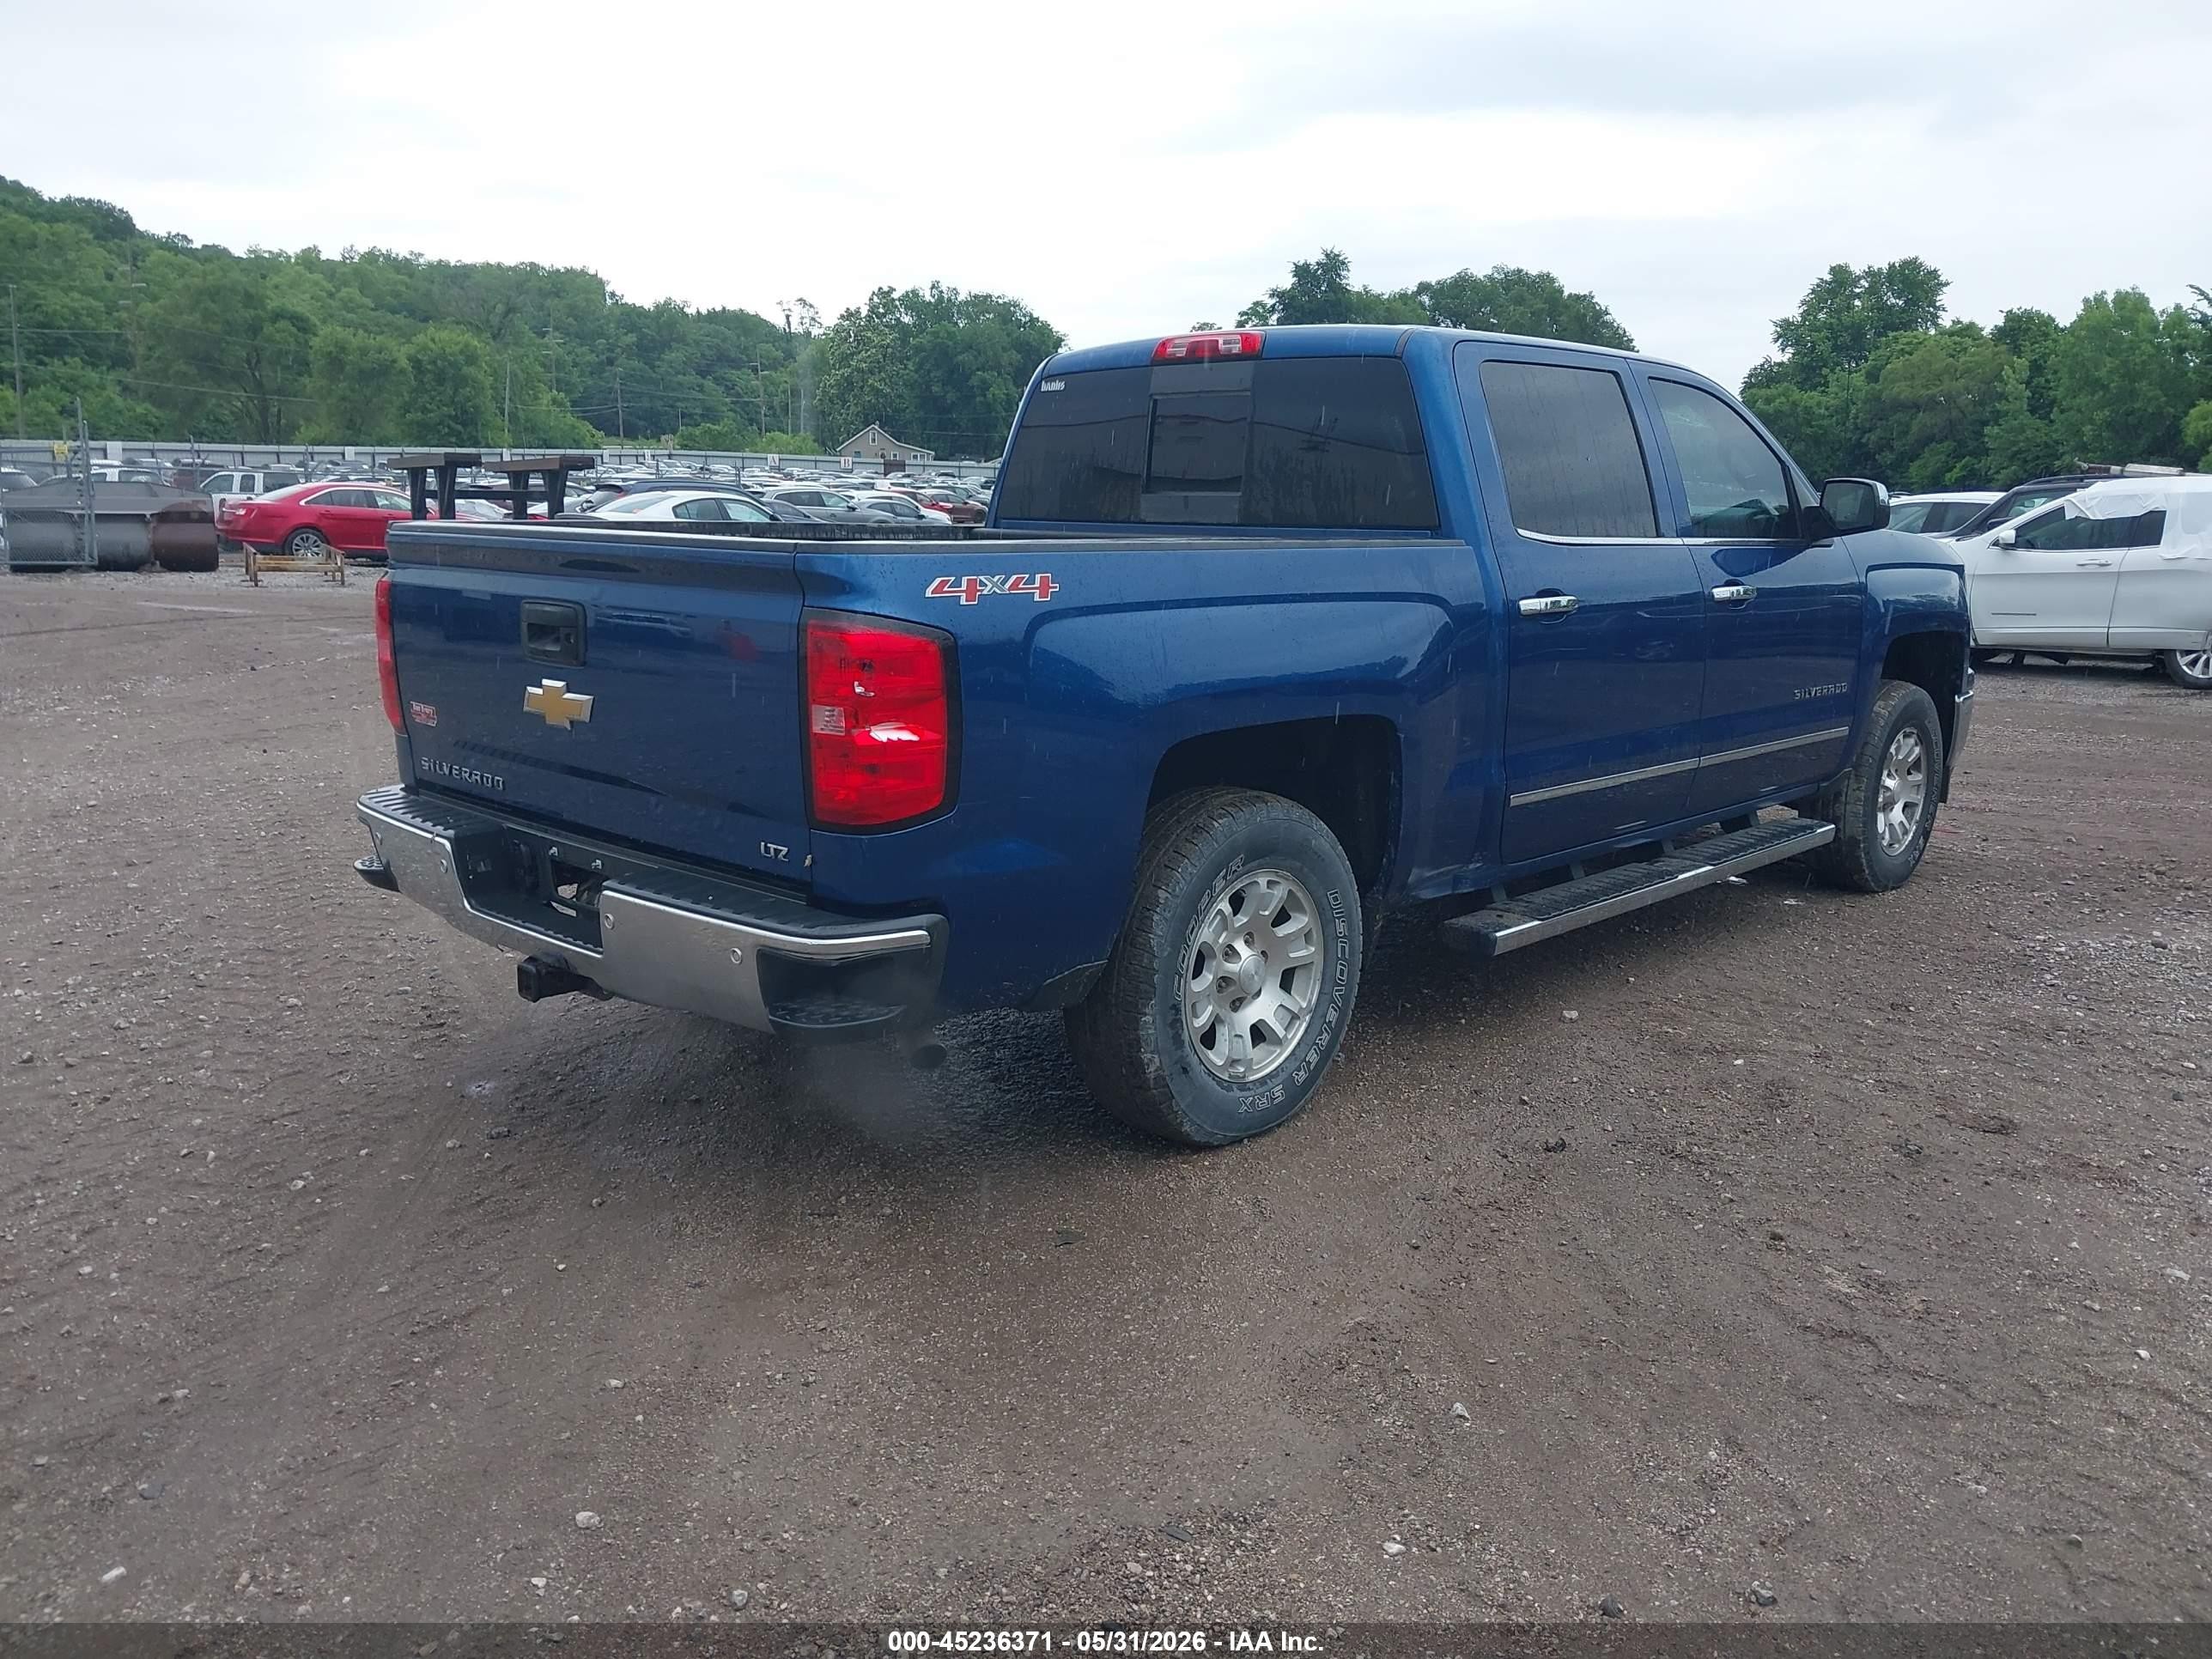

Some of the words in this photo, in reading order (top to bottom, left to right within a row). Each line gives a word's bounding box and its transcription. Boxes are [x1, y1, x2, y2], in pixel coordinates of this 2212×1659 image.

[1794, 683, 1848, 699] SILVERADO
[420, 757, 503, 790] SILVERADO
[760, 842, 789, 862] LTZ
[1173, 854, 1245, 1002] COOPER
[1291, 889, 1350, 1087] DISCOVERER
[1237, 1084, 1286, 1114] SRX
